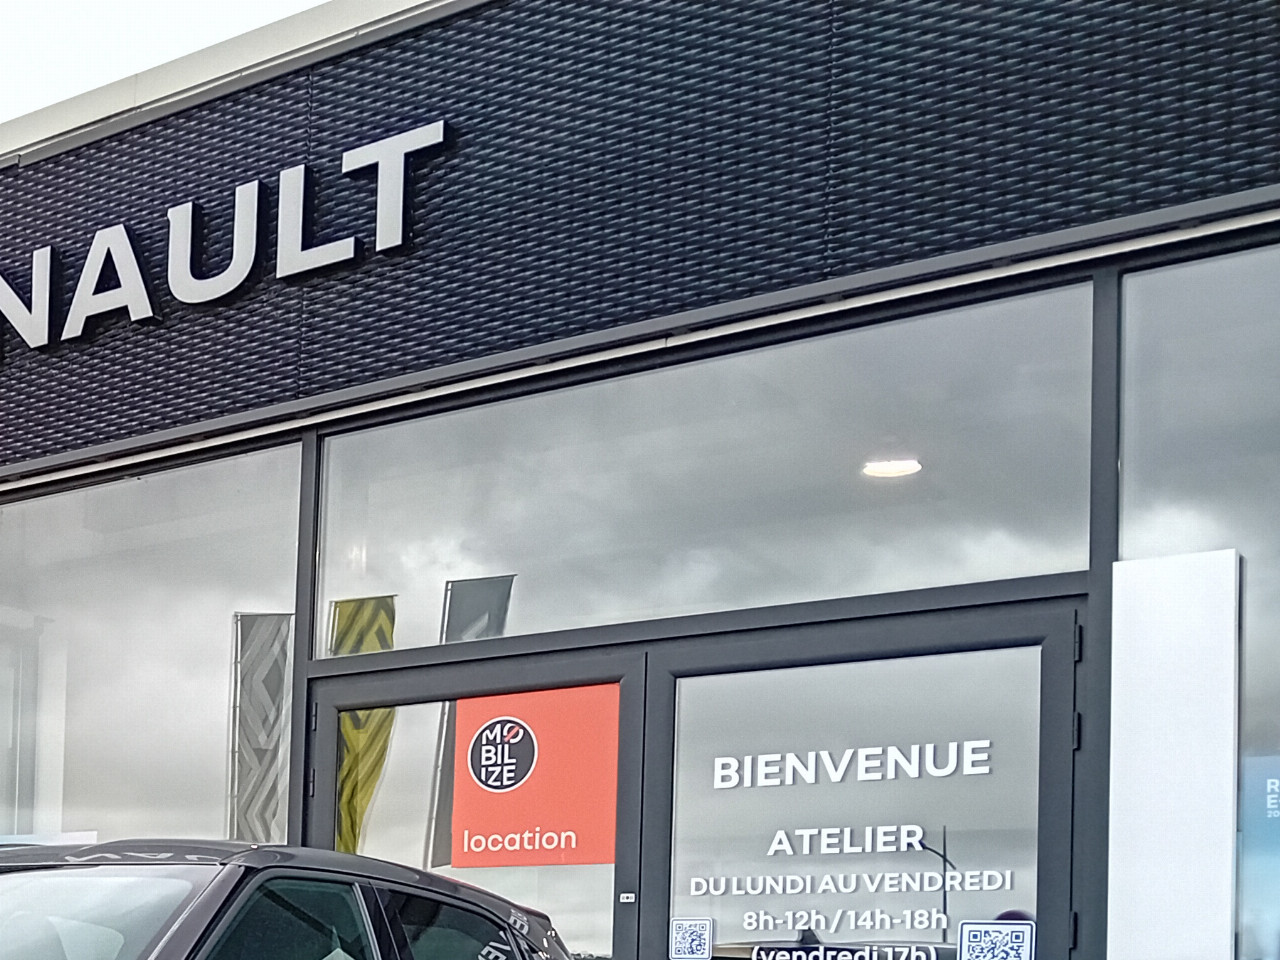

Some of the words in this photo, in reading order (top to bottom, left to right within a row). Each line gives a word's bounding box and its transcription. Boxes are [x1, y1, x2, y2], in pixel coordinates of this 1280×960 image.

[713, 740, 991, 789] BIENVENUE
[463, 827, 577, 852] location
[767, 824, 925, 855] ATELIER
[690, 877, 726, 896] DU
[732, 875, 812, 896] LUNDI
[817, 874, 858, 894] AU
[862, 870, 1012, 893] VENDREDI
[742, 910, 826, 931] 8h-12h
[848, 909, 948, 930] 14h-18h
